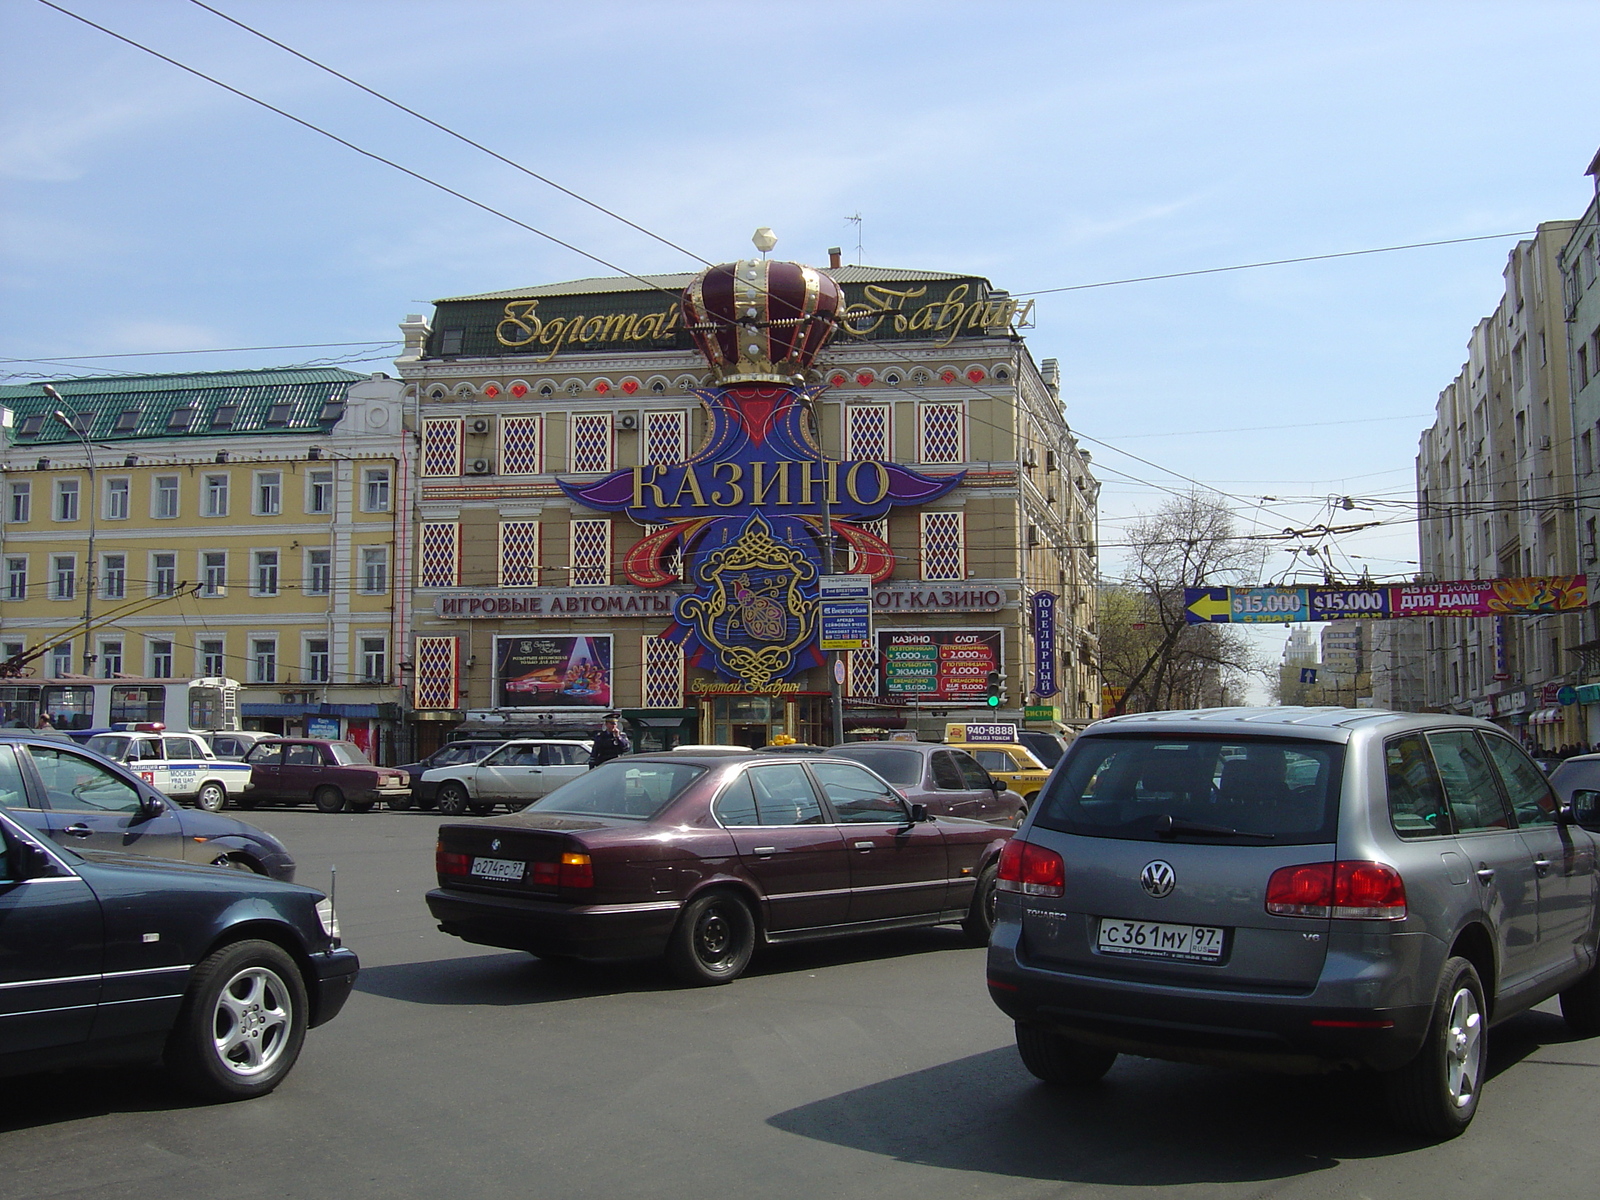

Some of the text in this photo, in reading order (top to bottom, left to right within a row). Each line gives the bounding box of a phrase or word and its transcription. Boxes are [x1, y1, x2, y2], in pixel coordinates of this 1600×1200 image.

[843, 283, 1035, 348] Павлин
[629, 460, 890, 509] КАЗИНО
[442, 595, 672, 614] ИГРОВЫЕ АВТОМАТЫ
[1233, 594, 1301, 613] $15.000
[1313, 592, 1383, 612] $15.000
[1401, 593, 1480, 609] ДЛЯ ДАМ!
[892, 635, 931, 644] КАЗИНО
[954, 635, 979, 644] СЛОТ
[1038, 598, 1052, 690] ЮВЕЛИРНЫЙ
[950, 650, 979, 659] 2.000
[895, 668, 933, 676] ЭКЗАМЕН
[950, 666, 980, 675] 4.000
[691, 677, 801, 698] Золотой Павлин
[966, 726, 1014, 735] 940-8888
[1107, 923, 1216, 949] С361МУ 97
[1302, 933, 1321, 942] V6
[1192, 945, 1208, 953] RUS
